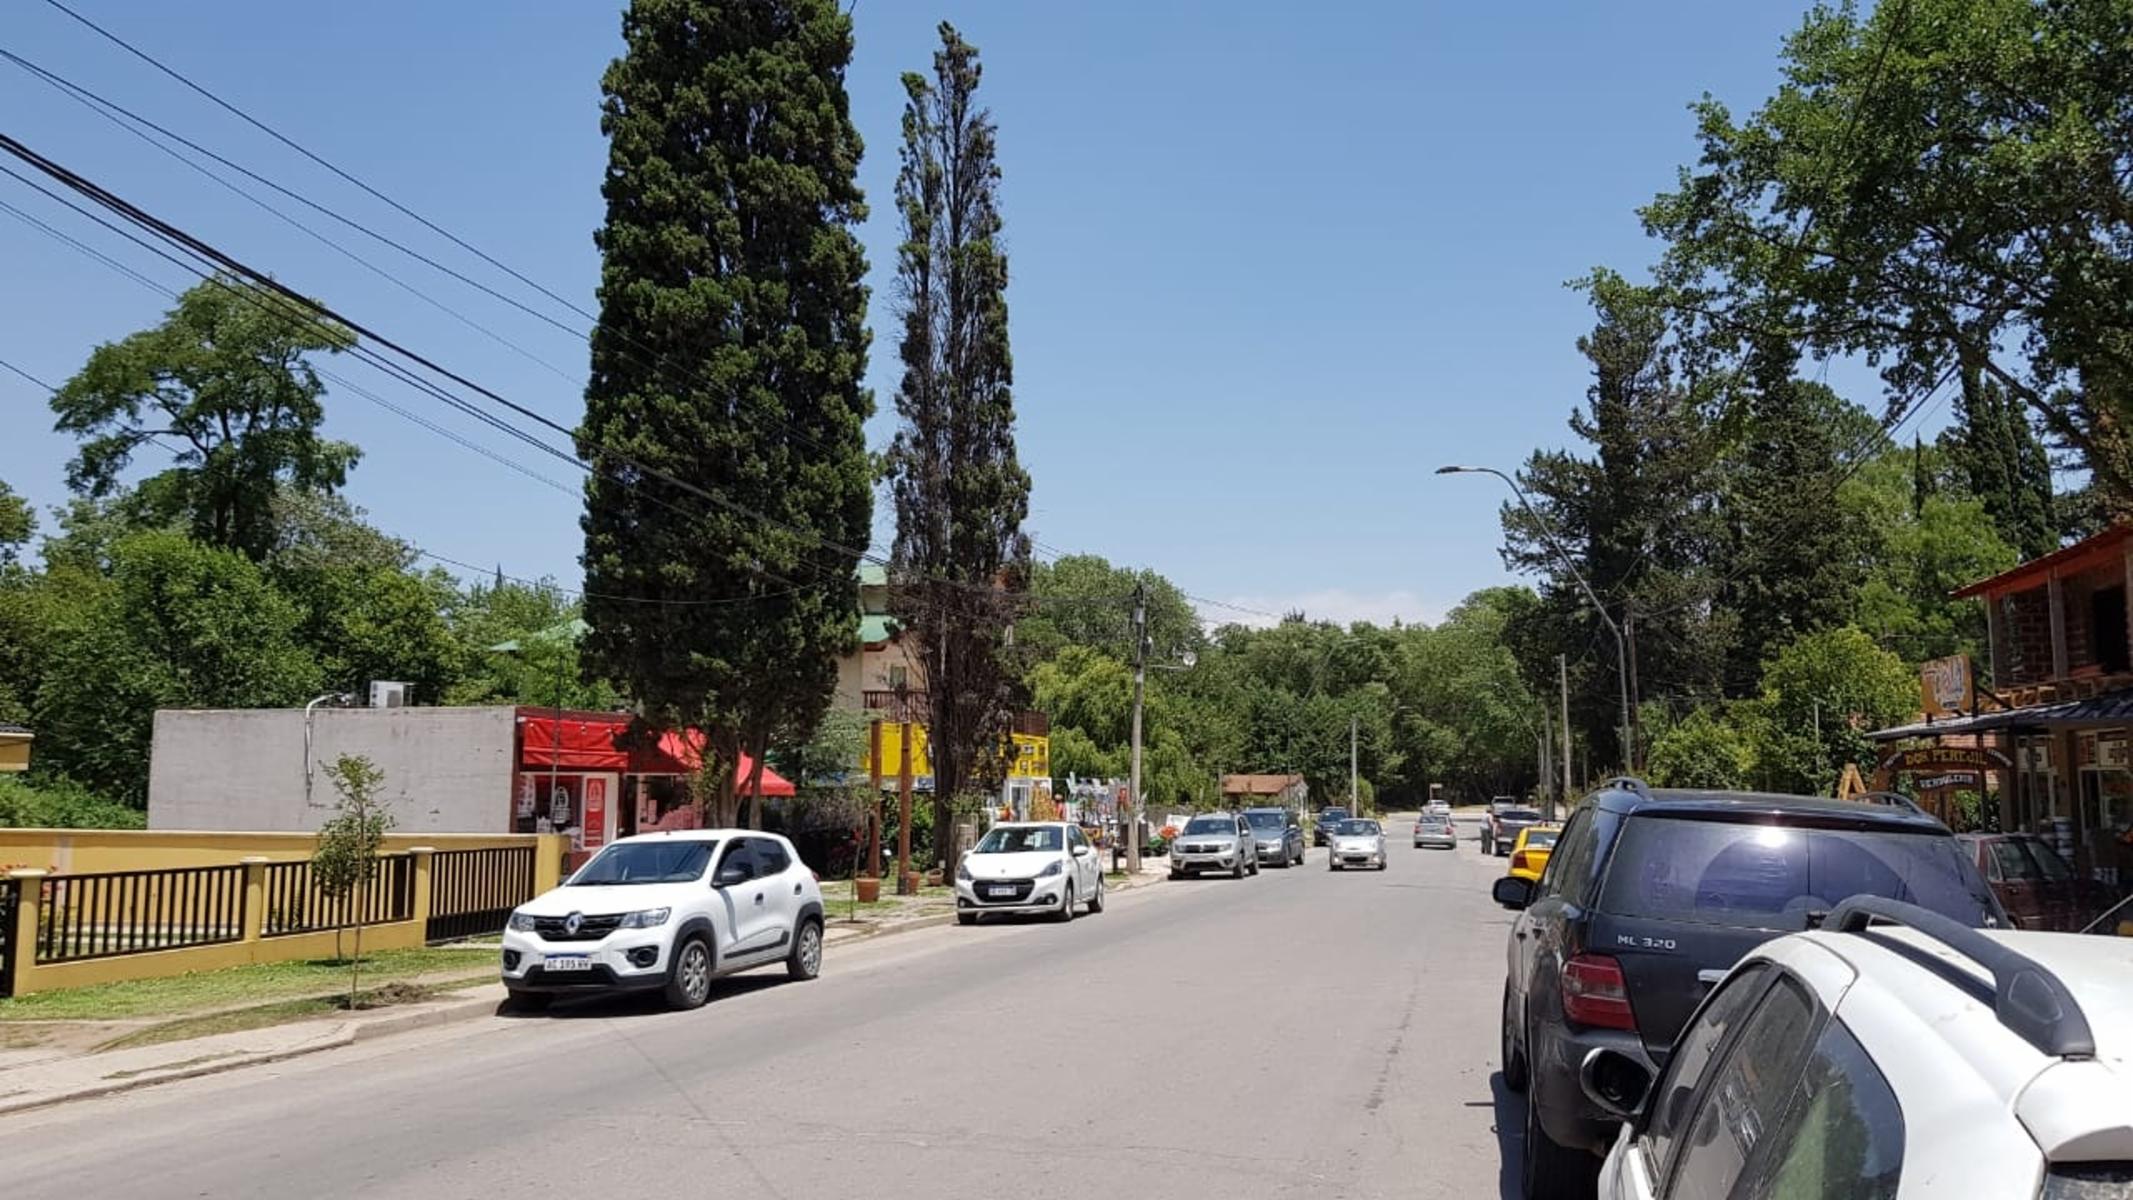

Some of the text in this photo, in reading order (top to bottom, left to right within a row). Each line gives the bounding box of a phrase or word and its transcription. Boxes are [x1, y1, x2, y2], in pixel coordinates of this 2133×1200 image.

[1932, 749, 1988, 766] PEREJIL
[1617, 934, 1676, 949] ML 320
